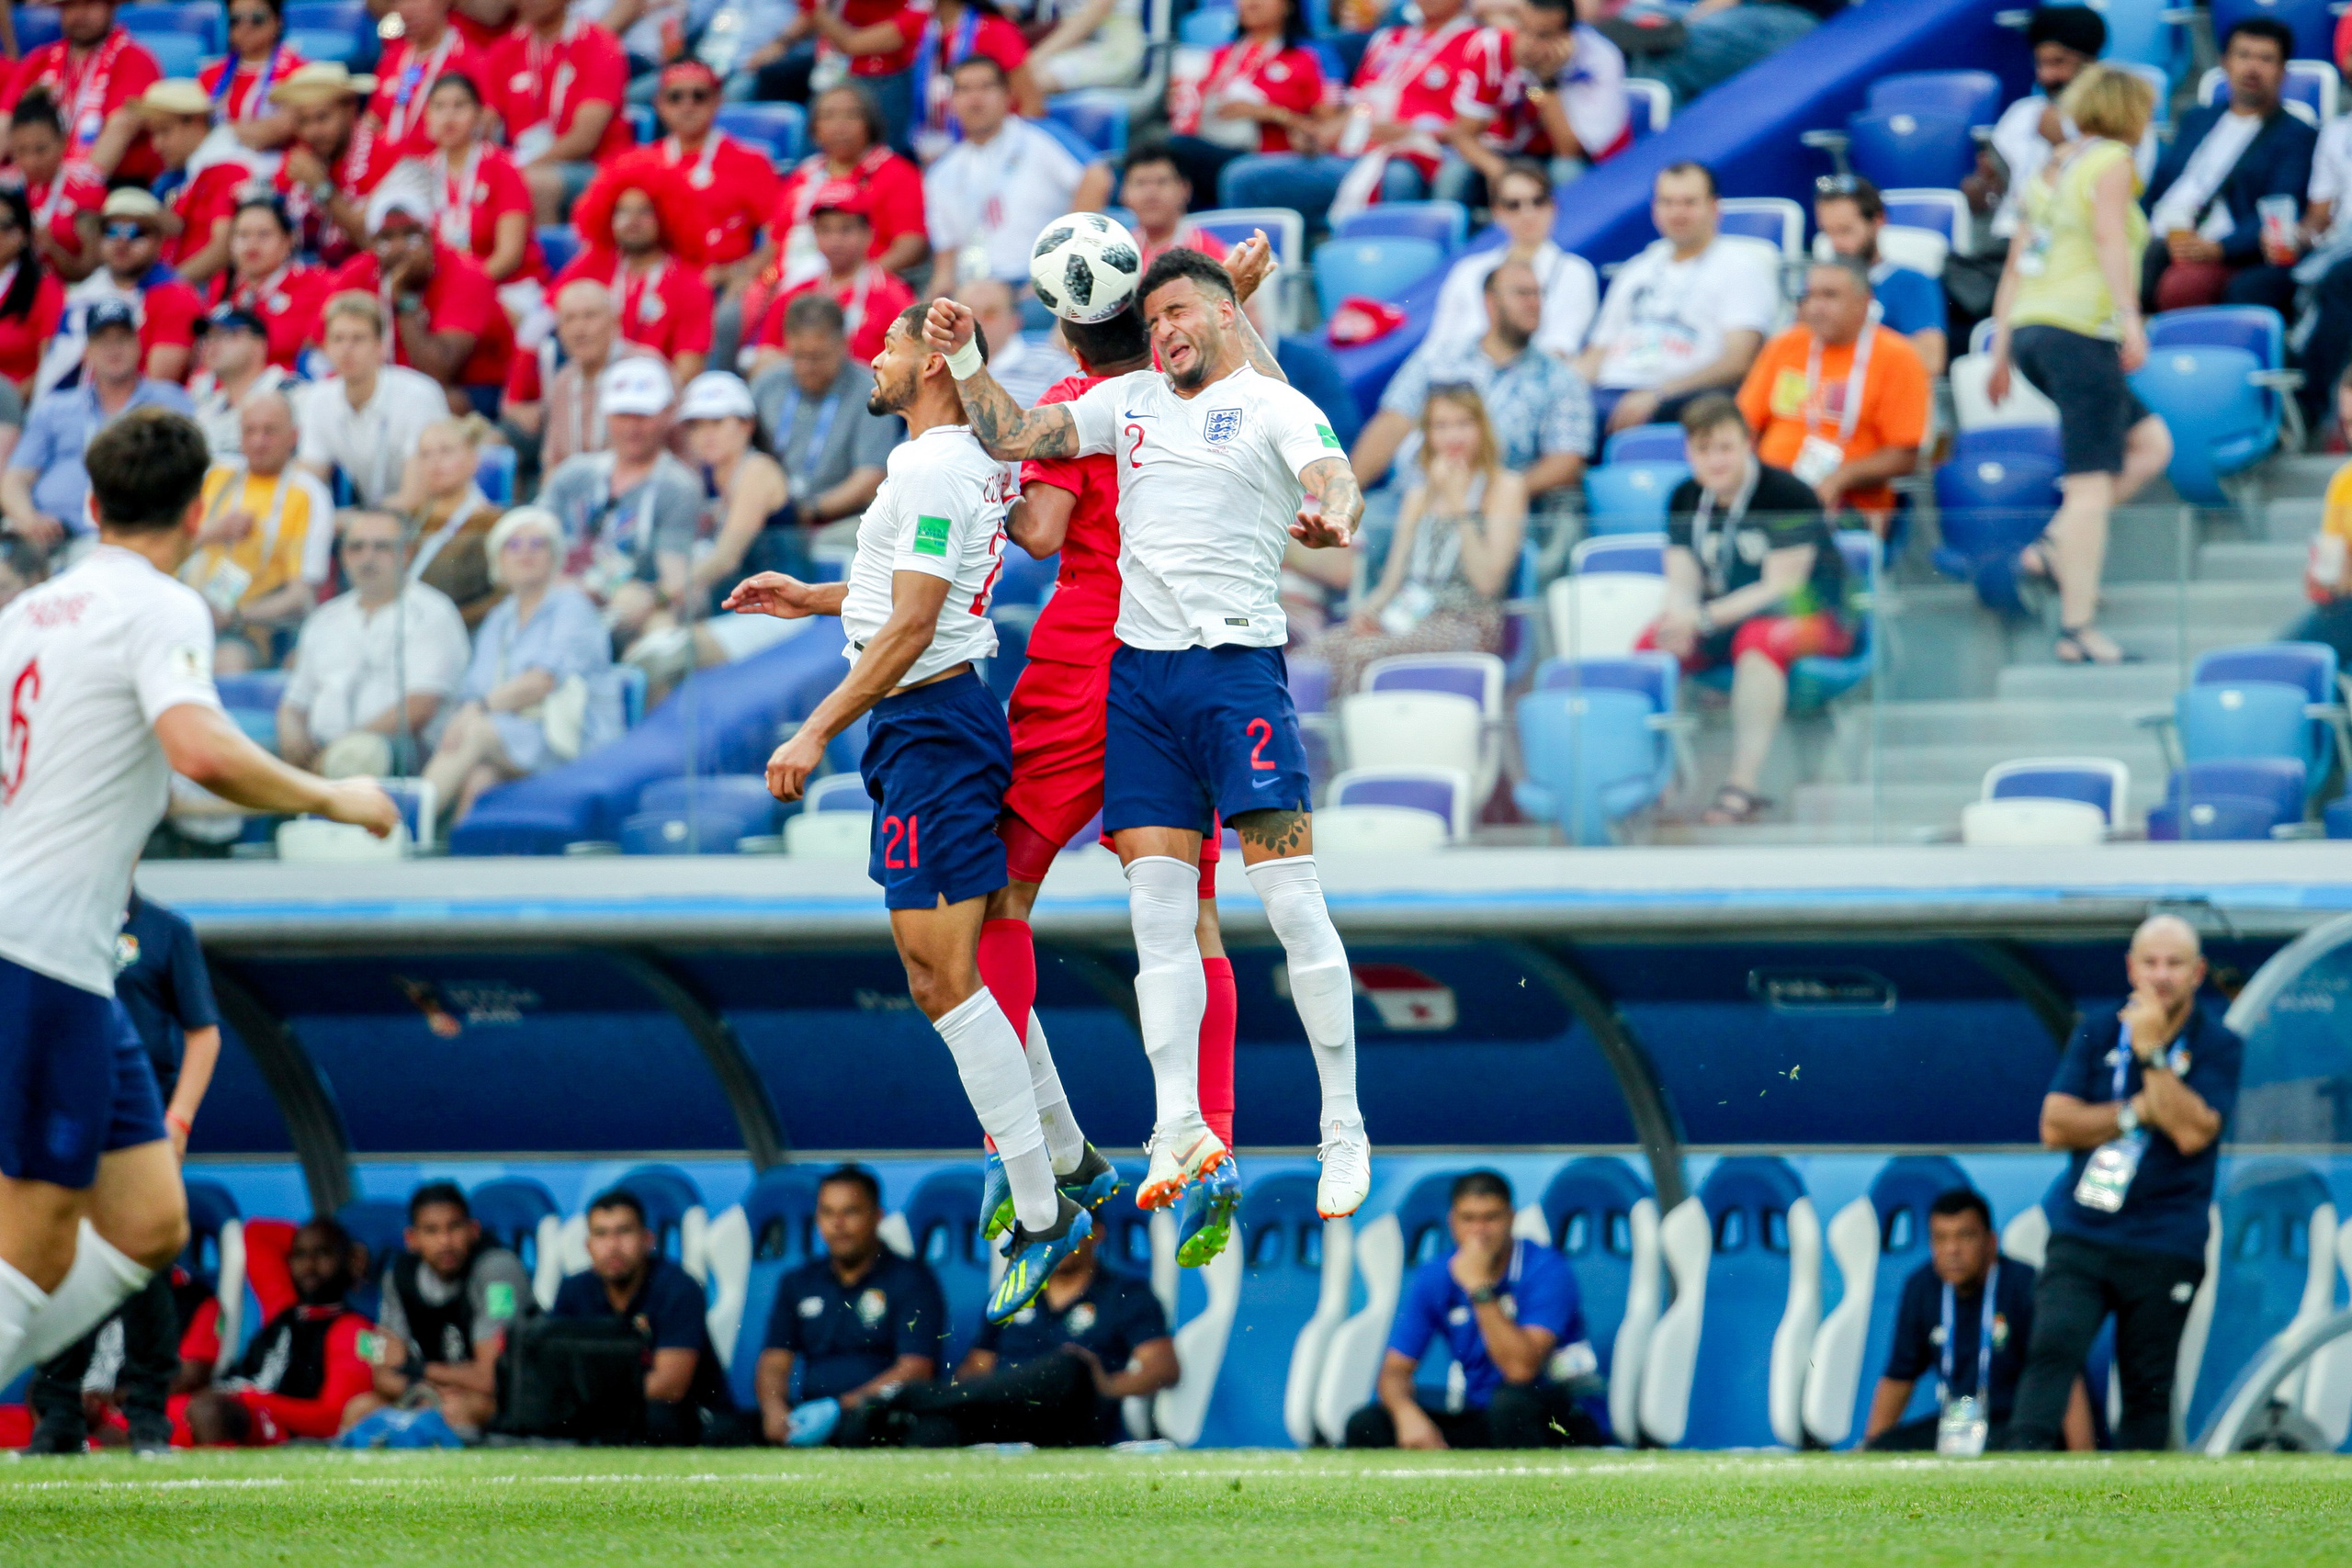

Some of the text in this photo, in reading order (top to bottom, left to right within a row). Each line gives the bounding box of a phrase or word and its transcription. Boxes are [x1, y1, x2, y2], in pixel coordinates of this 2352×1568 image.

[1125, 423, 1145, 468] 2
[1, 655, 40, 807] 6
[1246, 717, 1276, 770] 2
[882, 815, 919, 869] 21
